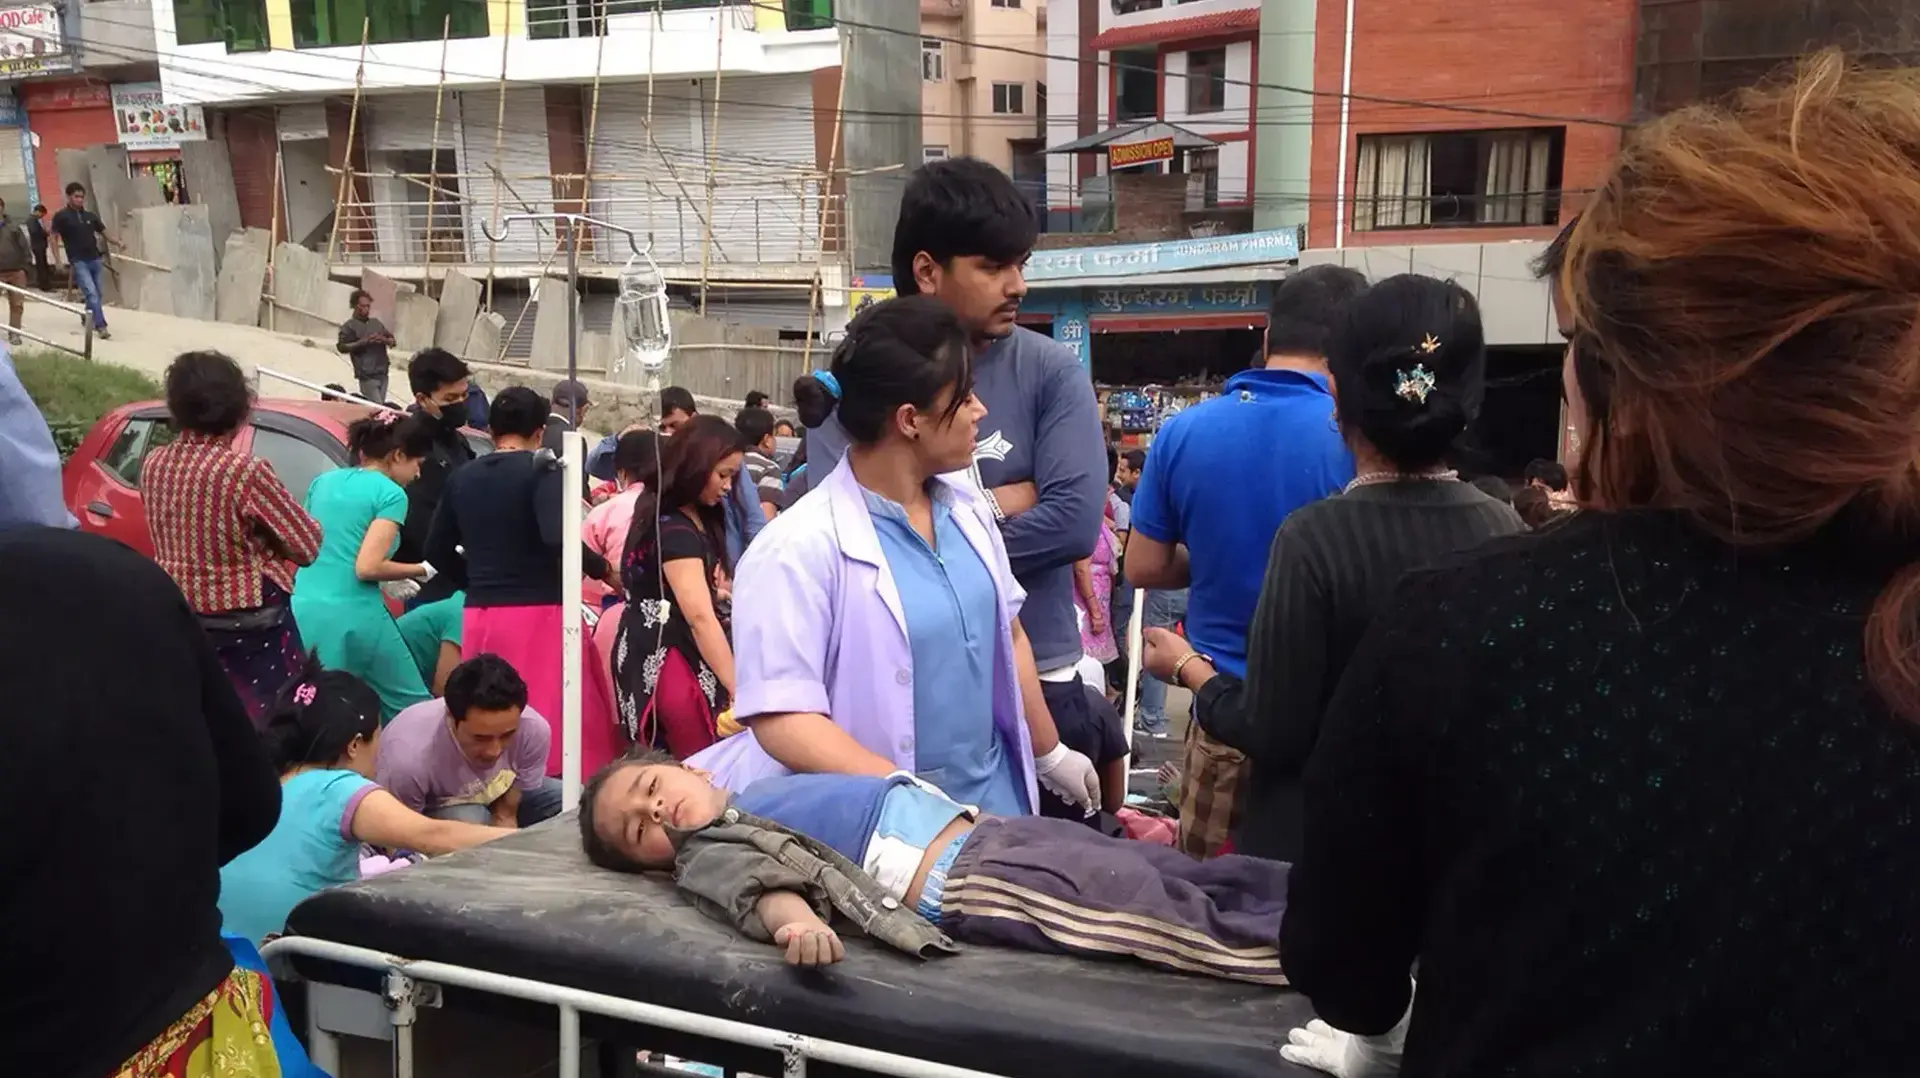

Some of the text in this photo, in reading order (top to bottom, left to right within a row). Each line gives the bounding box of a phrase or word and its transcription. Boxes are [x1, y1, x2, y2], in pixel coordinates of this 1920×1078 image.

[0, 11, 20, 28] OD
[1111, 139, 1173, 164] ADMISSION OPEN
[1241, 233, 1293, 251] PHARMA
